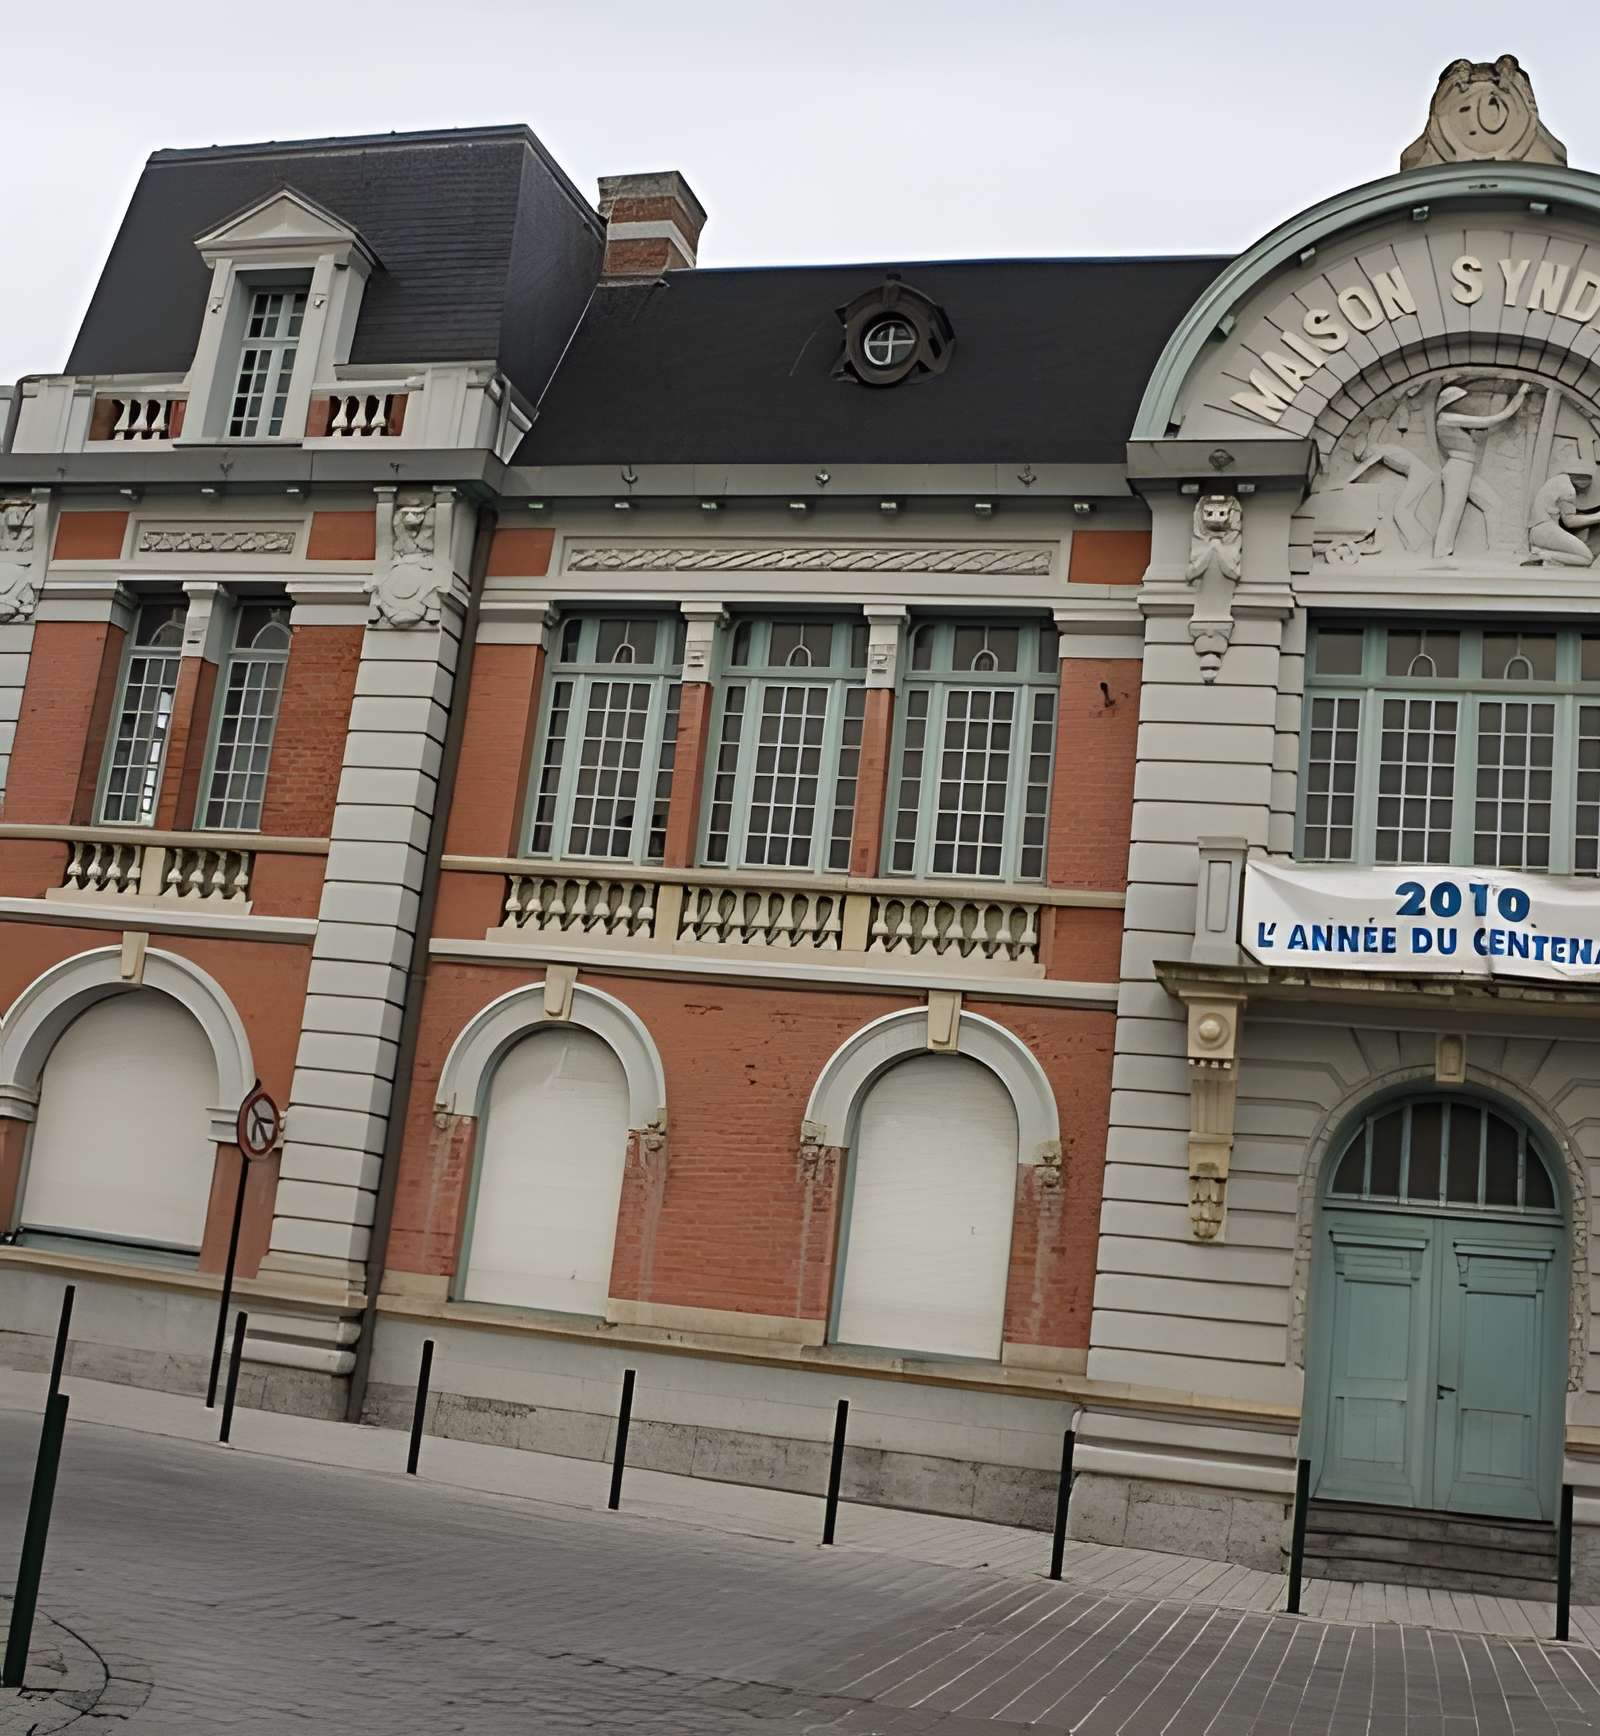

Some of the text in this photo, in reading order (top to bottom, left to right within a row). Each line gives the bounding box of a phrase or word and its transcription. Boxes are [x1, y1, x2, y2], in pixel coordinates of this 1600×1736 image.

[1229, 265, 1418, 424] MAISON
[1395, 881, 1531, 922] 2010
[1411, 927, 1457, 955] DU
